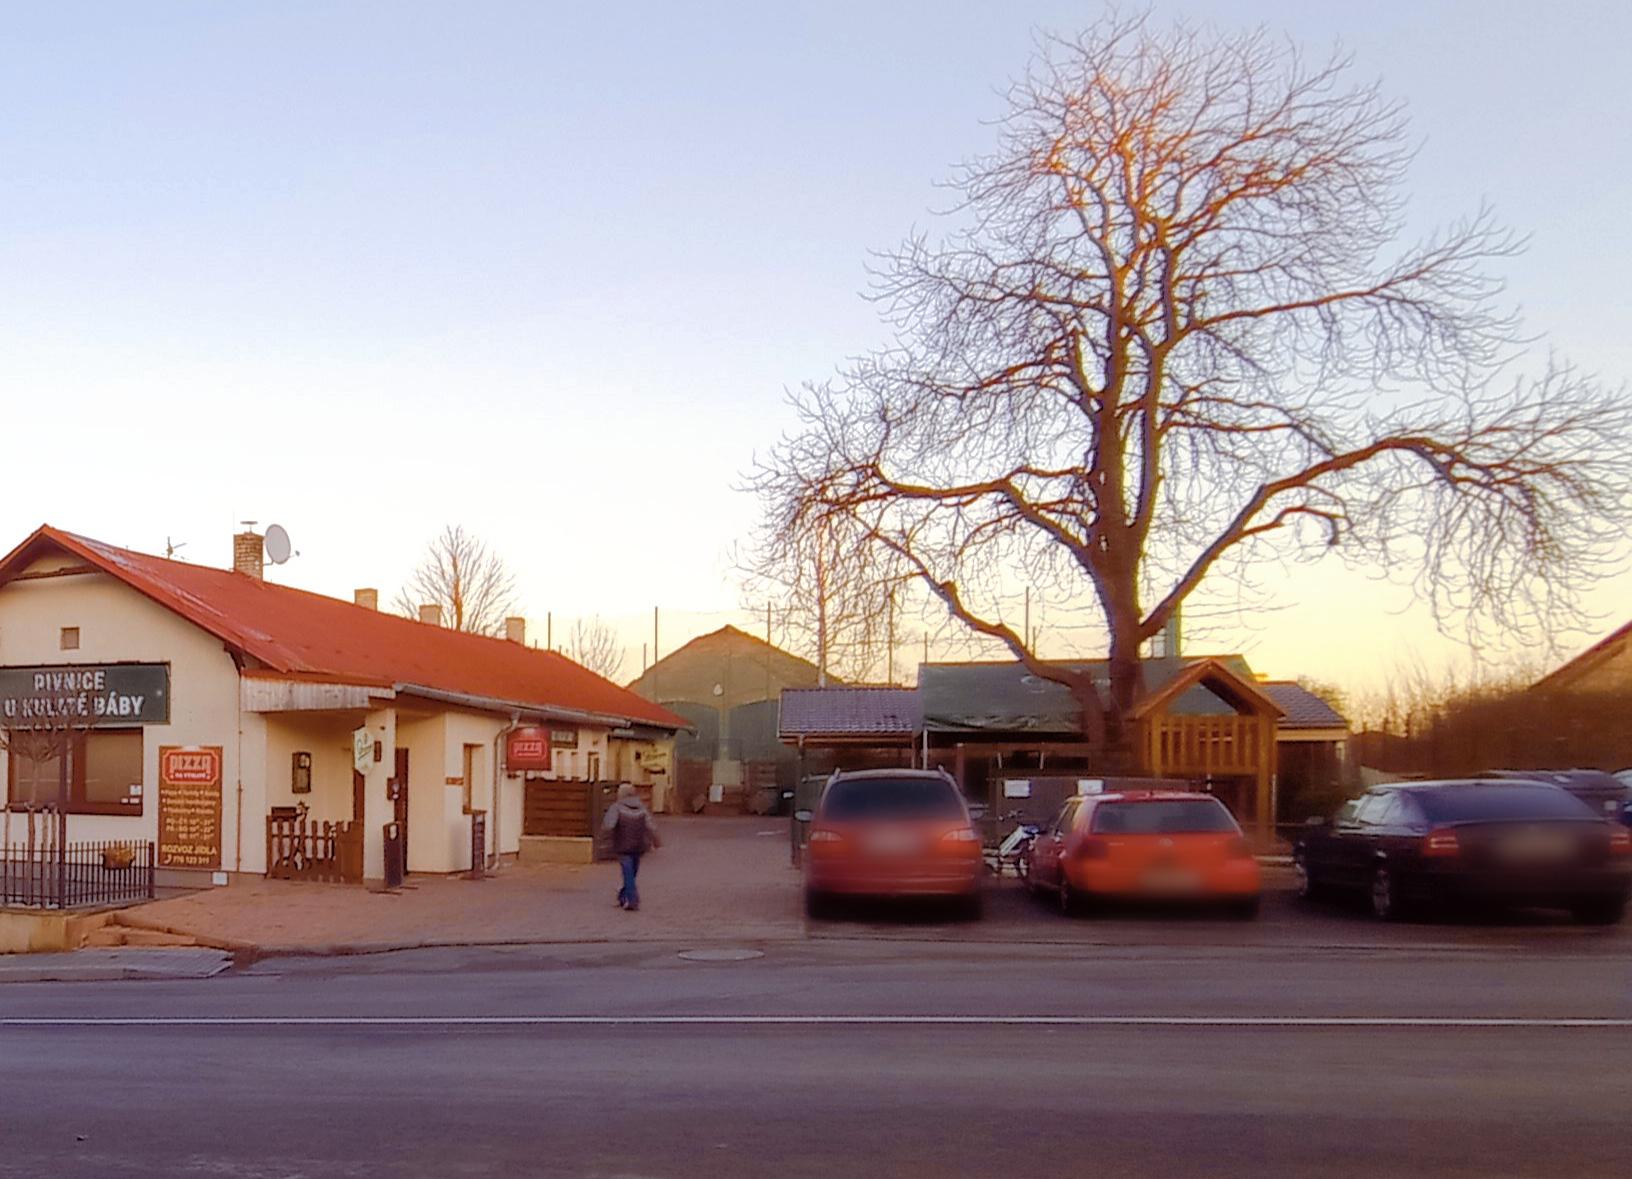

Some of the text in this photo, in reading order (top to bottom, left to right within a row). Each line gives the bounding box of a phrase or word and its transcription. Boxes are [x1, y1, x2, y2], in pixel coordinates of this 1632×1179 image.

[34, 671, 106, 691] PIVNICE
[3, 699, 18, 718] U
[93, 691, 145, 717] BÁBY
[169, 755, 211, 774] PIZZA
